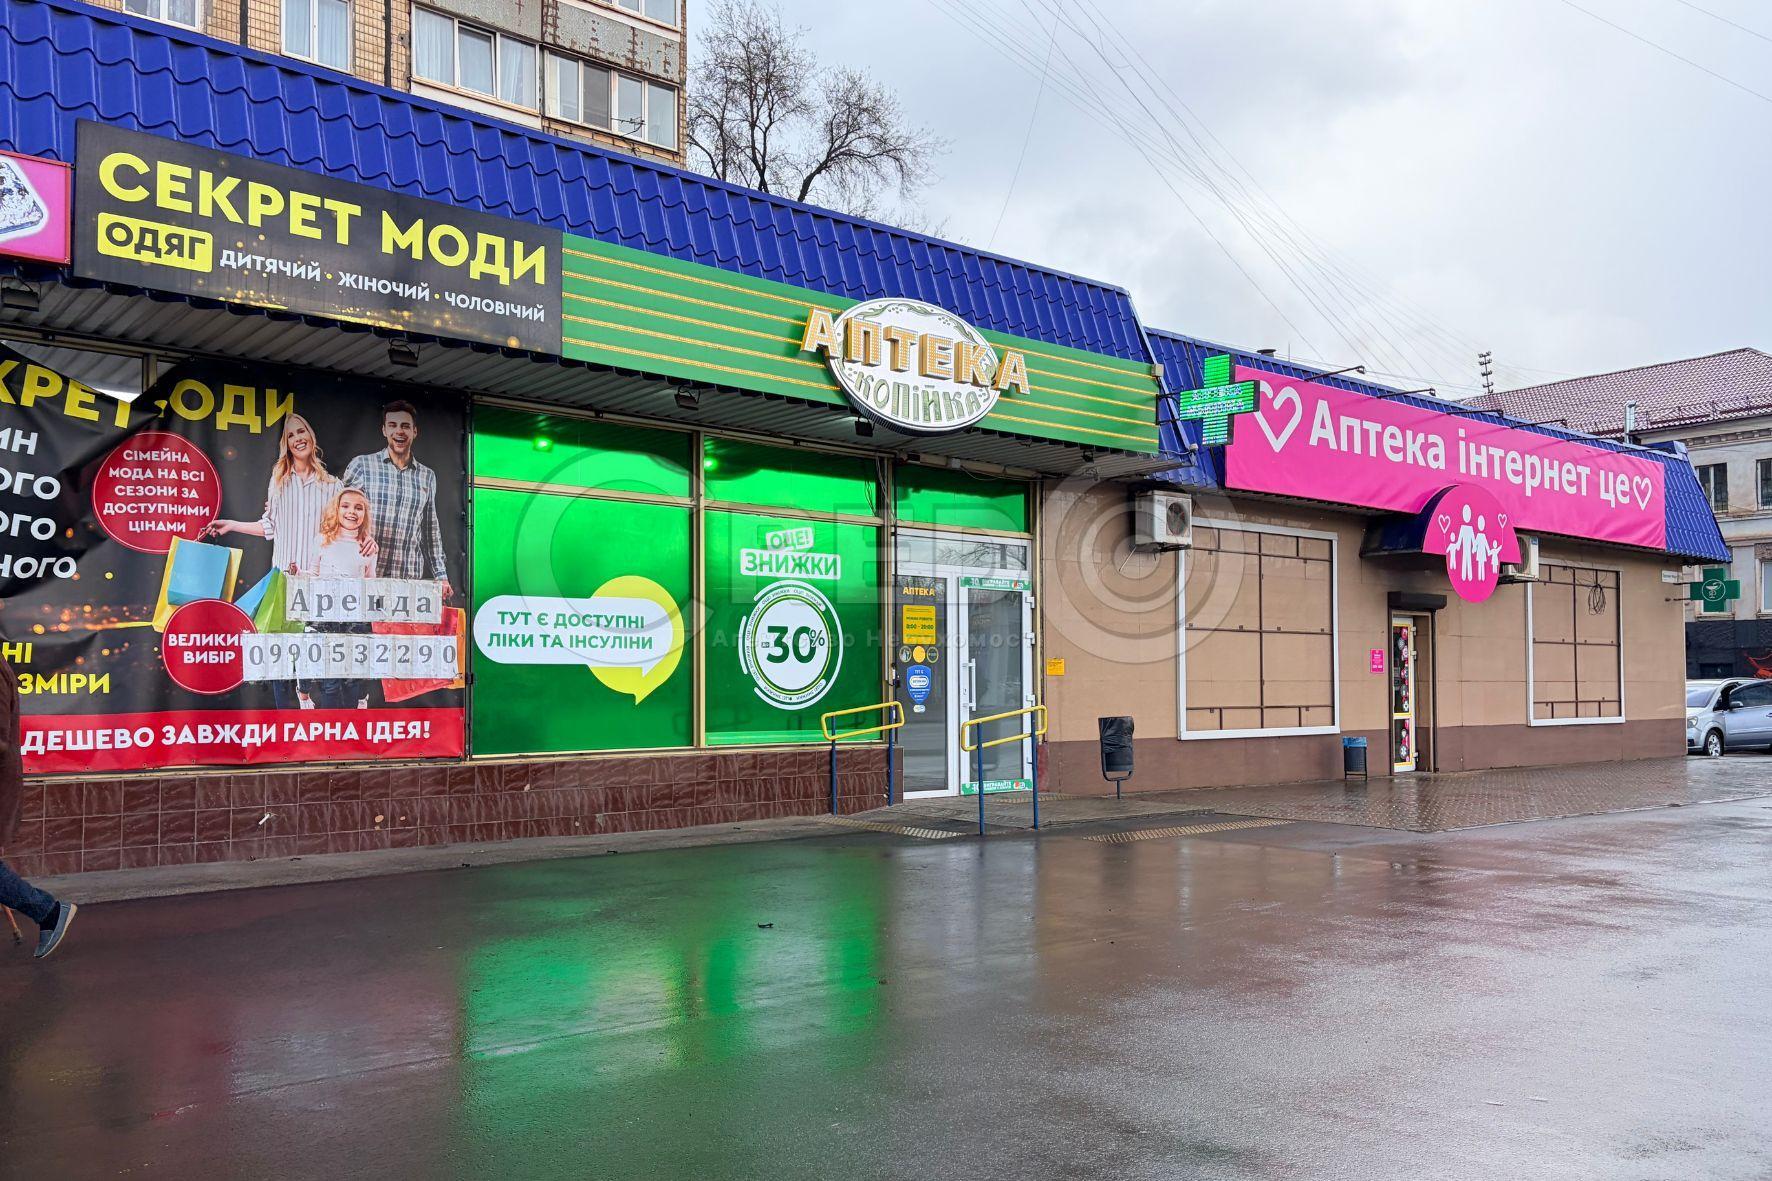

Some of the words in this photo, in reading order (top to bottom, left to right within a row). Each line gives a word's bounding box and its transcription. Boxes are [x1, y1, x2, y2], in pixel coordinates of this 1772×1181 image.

[98, 152, 361, 246] СЕКРЕТ
[381, 210, 545, 286] МОДИ
[105, 222, 206, 259] ОДЯГ
[220, 249, 320, 282] ДИТЯЧИЙ
[338, 271, 430, 302] ЖІНОЧИЙ
[444, 291, 545, 322] ЧОЛОВІЧИЙ
[800, 307, 1030, 395] АПТЕКА
[154, 379, 293, 434] ОДИ
[123, 448, 190, 464] СІМЕЙНА
[1309, 399, 1446, 470] Аптека
[1458, 428, 1591, 497] інтернет
[1600, 470, 1630, 508] це
[109, 467, 153, 481] МОДА
[158, 468, 179, 480] НА
[181, 471, 205, 482] ВСІ
[114, 485, 178, 497] СЕЗОНИ
[181, 488, 199, 499] ЗА
[103, 503, 209, 517] ДОСТУПНИМИ
[129, 521, 186, 533] ЦІНАМИ
[770, 529, 810, 550] ОЦЕ!
[745, 552, 838, 577] ЗНИЖКИ
[290, 588, 432, 618] Аренда
[902, 586, 936, 597] АПТЕКА
[497, 611, 532, 626] ТУТ
[537, 612, 549, 626] Є
[553, 613, 645, 630] ДОСТУПНІ
[487, 632, 534, 648] ЛІКИ
[540, 634, 564, 648] ТА
[569, 635, 653, 650] ІНСУЛІНИ
[766, 626, 826, 664] 30%
[183, 650, 236, 664] ВИБІР
[249, 643, 457, 666] 0990532290
[17, 672, 110, 695] ЗМІРИ
[20, 727, 155, 756] ДЕШЕВО
[161, 723, 276, 748] ЗАВЖДИ
[284, 721, 359, 743] ГАРНА
[366, 720, 431, 744] ІДЕЯ!
